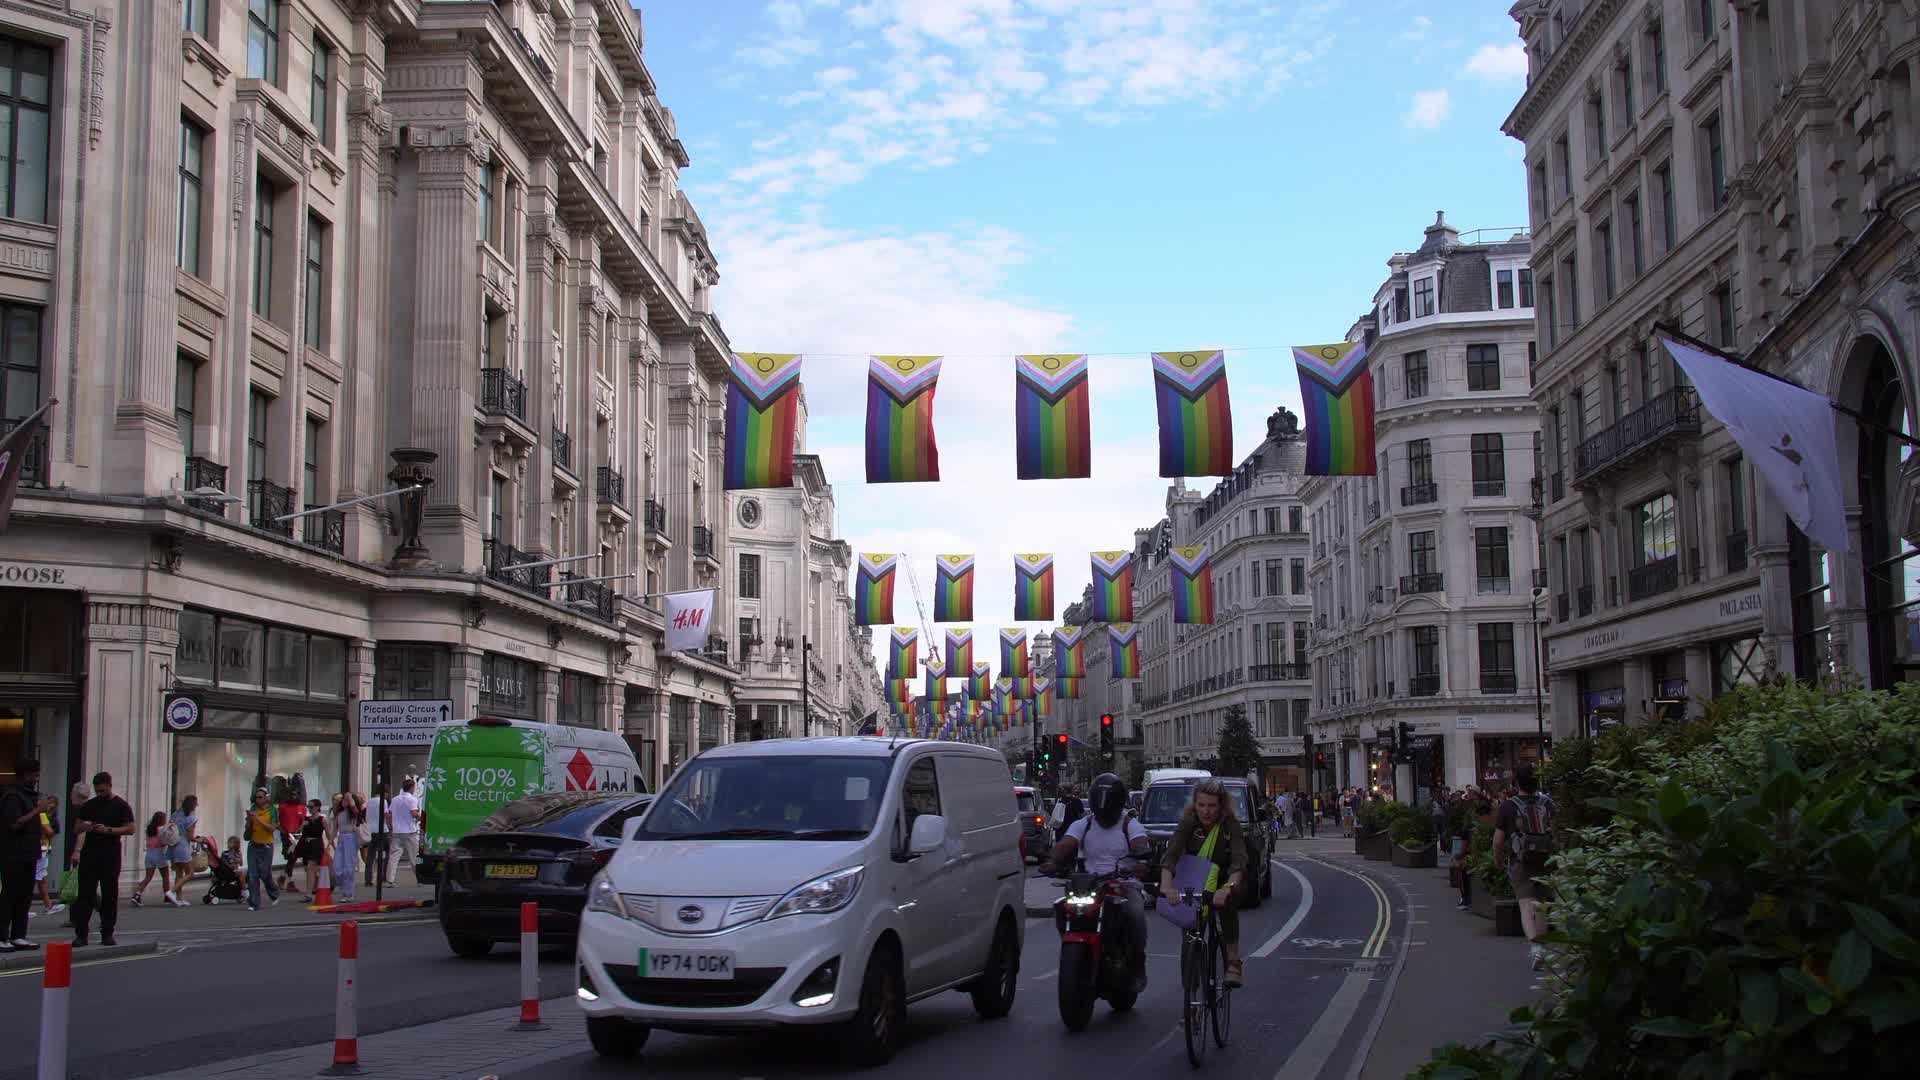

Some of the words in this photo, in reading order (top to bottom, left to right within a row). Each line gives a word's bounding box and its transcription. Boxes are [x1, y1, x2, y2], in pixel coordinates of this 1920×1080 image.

[0, 565, 65, 584] OOSE
[673, 608, 705, 631] H&M
[363, 704, 405, 715] Piccadilly
[408, 704, 437, 714] Circus
[363, 715, 402, 725] Trafalgar
[406, 715, 437, 725] Square
[373, 732, 404, 741] Marble
[407, 732, 428, 741] Arch
[456, 767, 517, 787] 100%
[454, 786, 516, 803] electric
[650, 953, 691, 971] YP74
